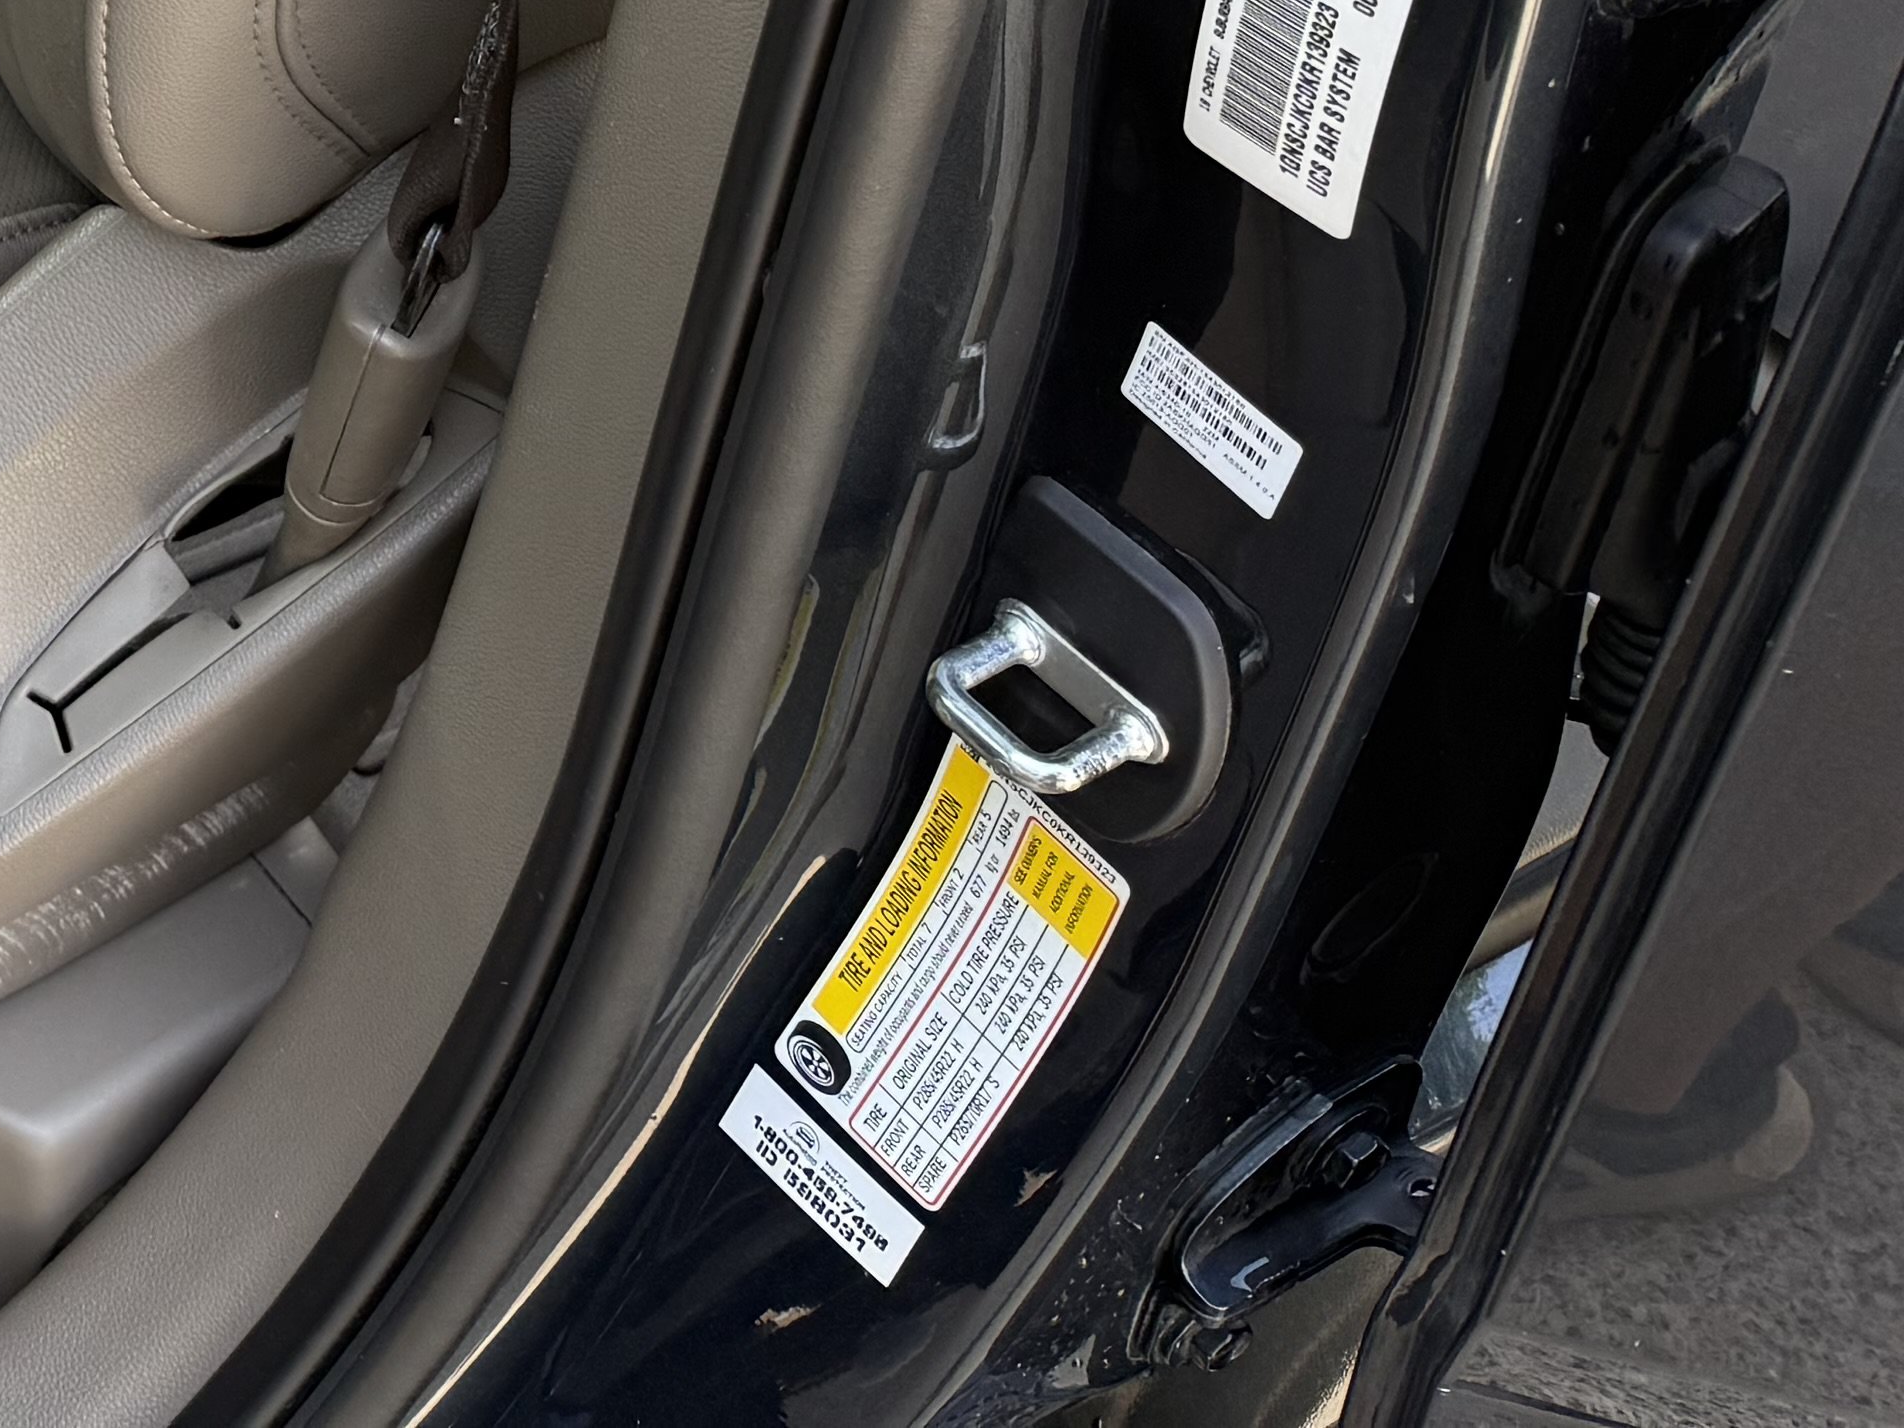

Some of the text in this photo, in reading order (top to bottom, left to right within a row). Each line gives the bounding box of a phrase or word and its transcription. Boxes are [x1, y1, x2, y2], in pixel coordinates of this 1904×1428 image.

[1201, 45, 1220, 98] CHEVROLET
[1322, 47, 1361, 123] SYSTEM
[1313, 121, 1342, 162] BAR
[1305, 159, 1332, 198] UCS
[969, 873, 987, 899] 677
[994, 817, 1014, 848] 1494
[971, 809, 992, 844] REAR 5
[837, 788, 963, 992] TIRE AND LOADING INFORMATION
[938, 867, 964, 908] FRONT 2
[905, 921, 932, 961] TOTAL 7
[948, 890, 1020, 1004] COLD TIRE PRESSURE
[974, 991, 993, 1016] 240
[999, 954, 1015, 974] 35
[1008, 934, 1027, 959] PSI
[993, 1010, 1013, 1035] 240
[1019, 973, 1035, 993] 35
[1027, 954, 1046, 978] PSI
[850, 971, 903, 1047] SEATING CAPACITY
[1010, 1025, 1030, 1052] 240
[1035, 990, 1052, 1010] 35
[1044, 970, 1064, 995] PSI
[891, 1010, 948, 1090] ORIGINAL SIZE
[911, 1037, 964, 1111] P285/45R22 H
[985, 1073, 1000, 1089] S
[862, 1102, 888, 1132] TIRE
[930, 1056, 983, 1129] P285/45R22 H
[879, 1117, 909, 1157] FRONT
[900, 1143, 926, 1177] REAR
[918, 1152, 947, 1193] SPARE
